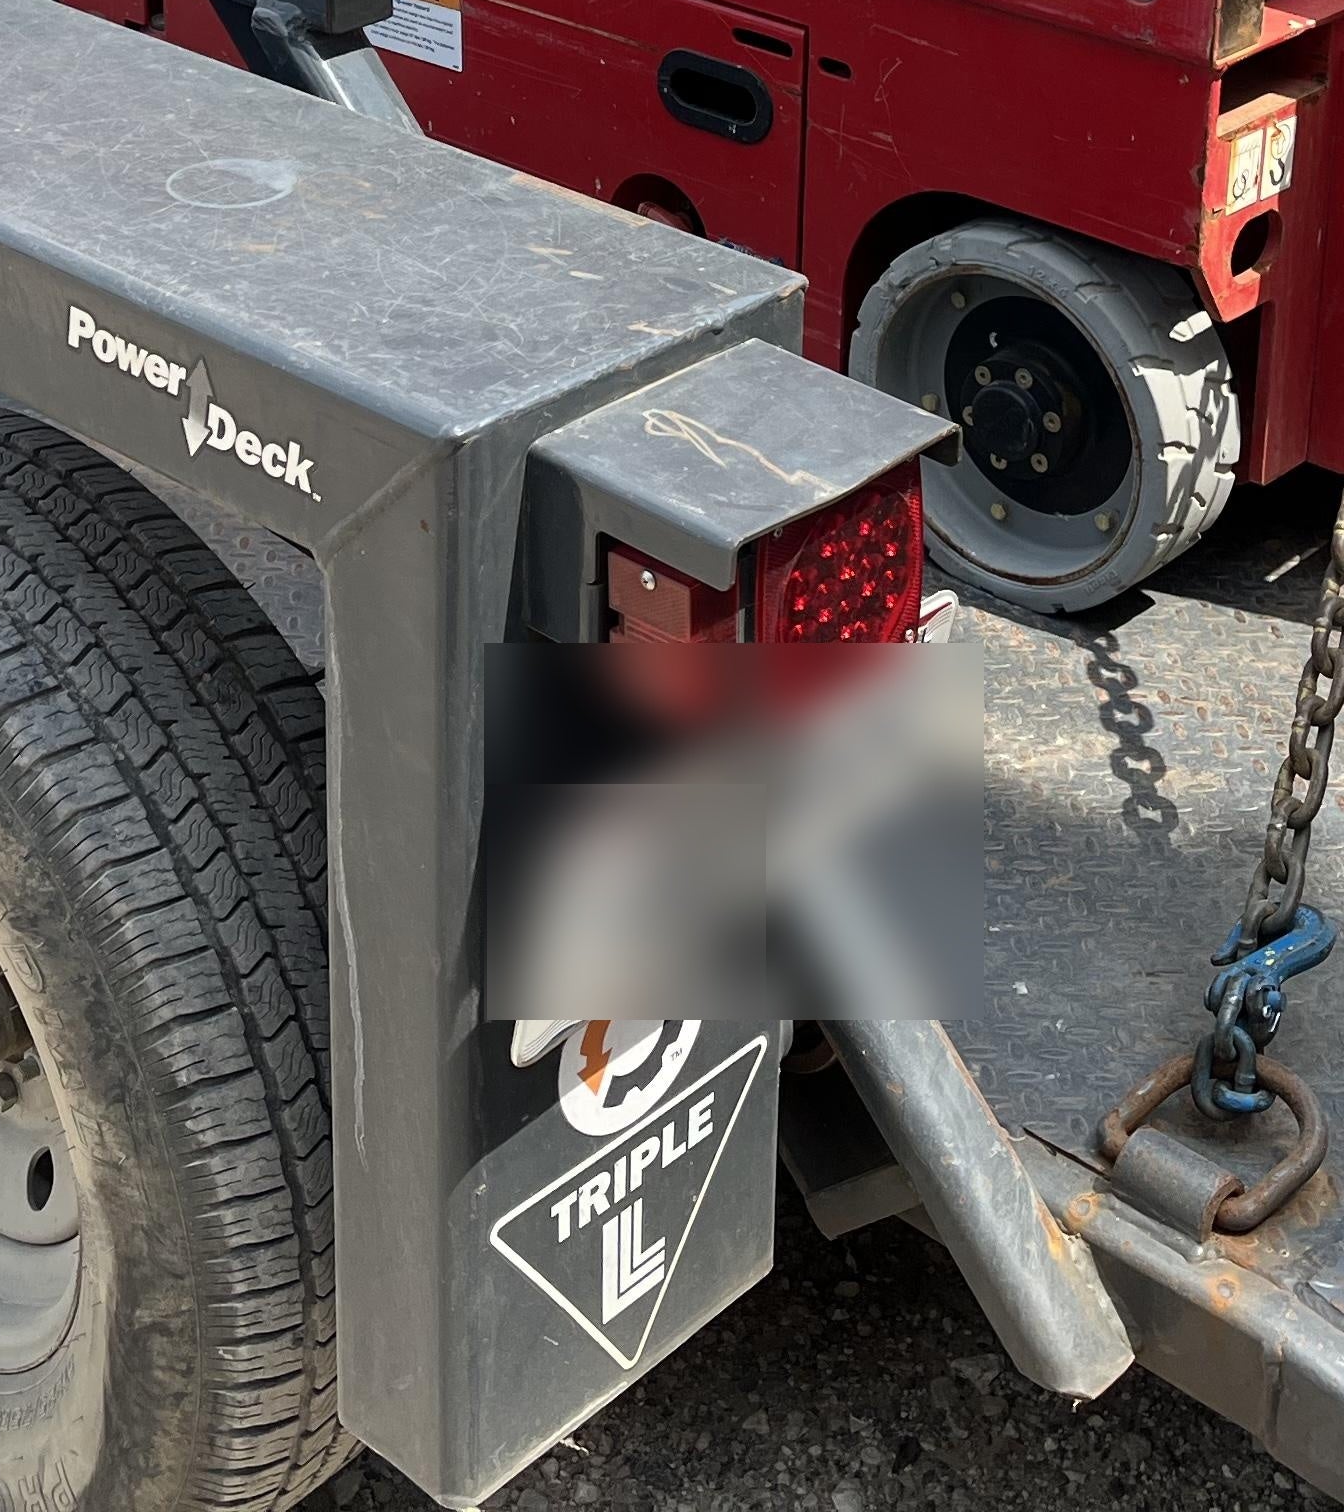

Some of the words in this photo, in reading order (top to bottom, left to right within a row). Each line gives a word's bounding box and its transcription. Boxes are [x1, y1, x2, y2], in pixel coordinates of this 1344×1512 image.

[67, 304, 188, 397] Power
[206, 402, 315, 494] Deck
[550, 1091, 715, 1244] TRIPLE
